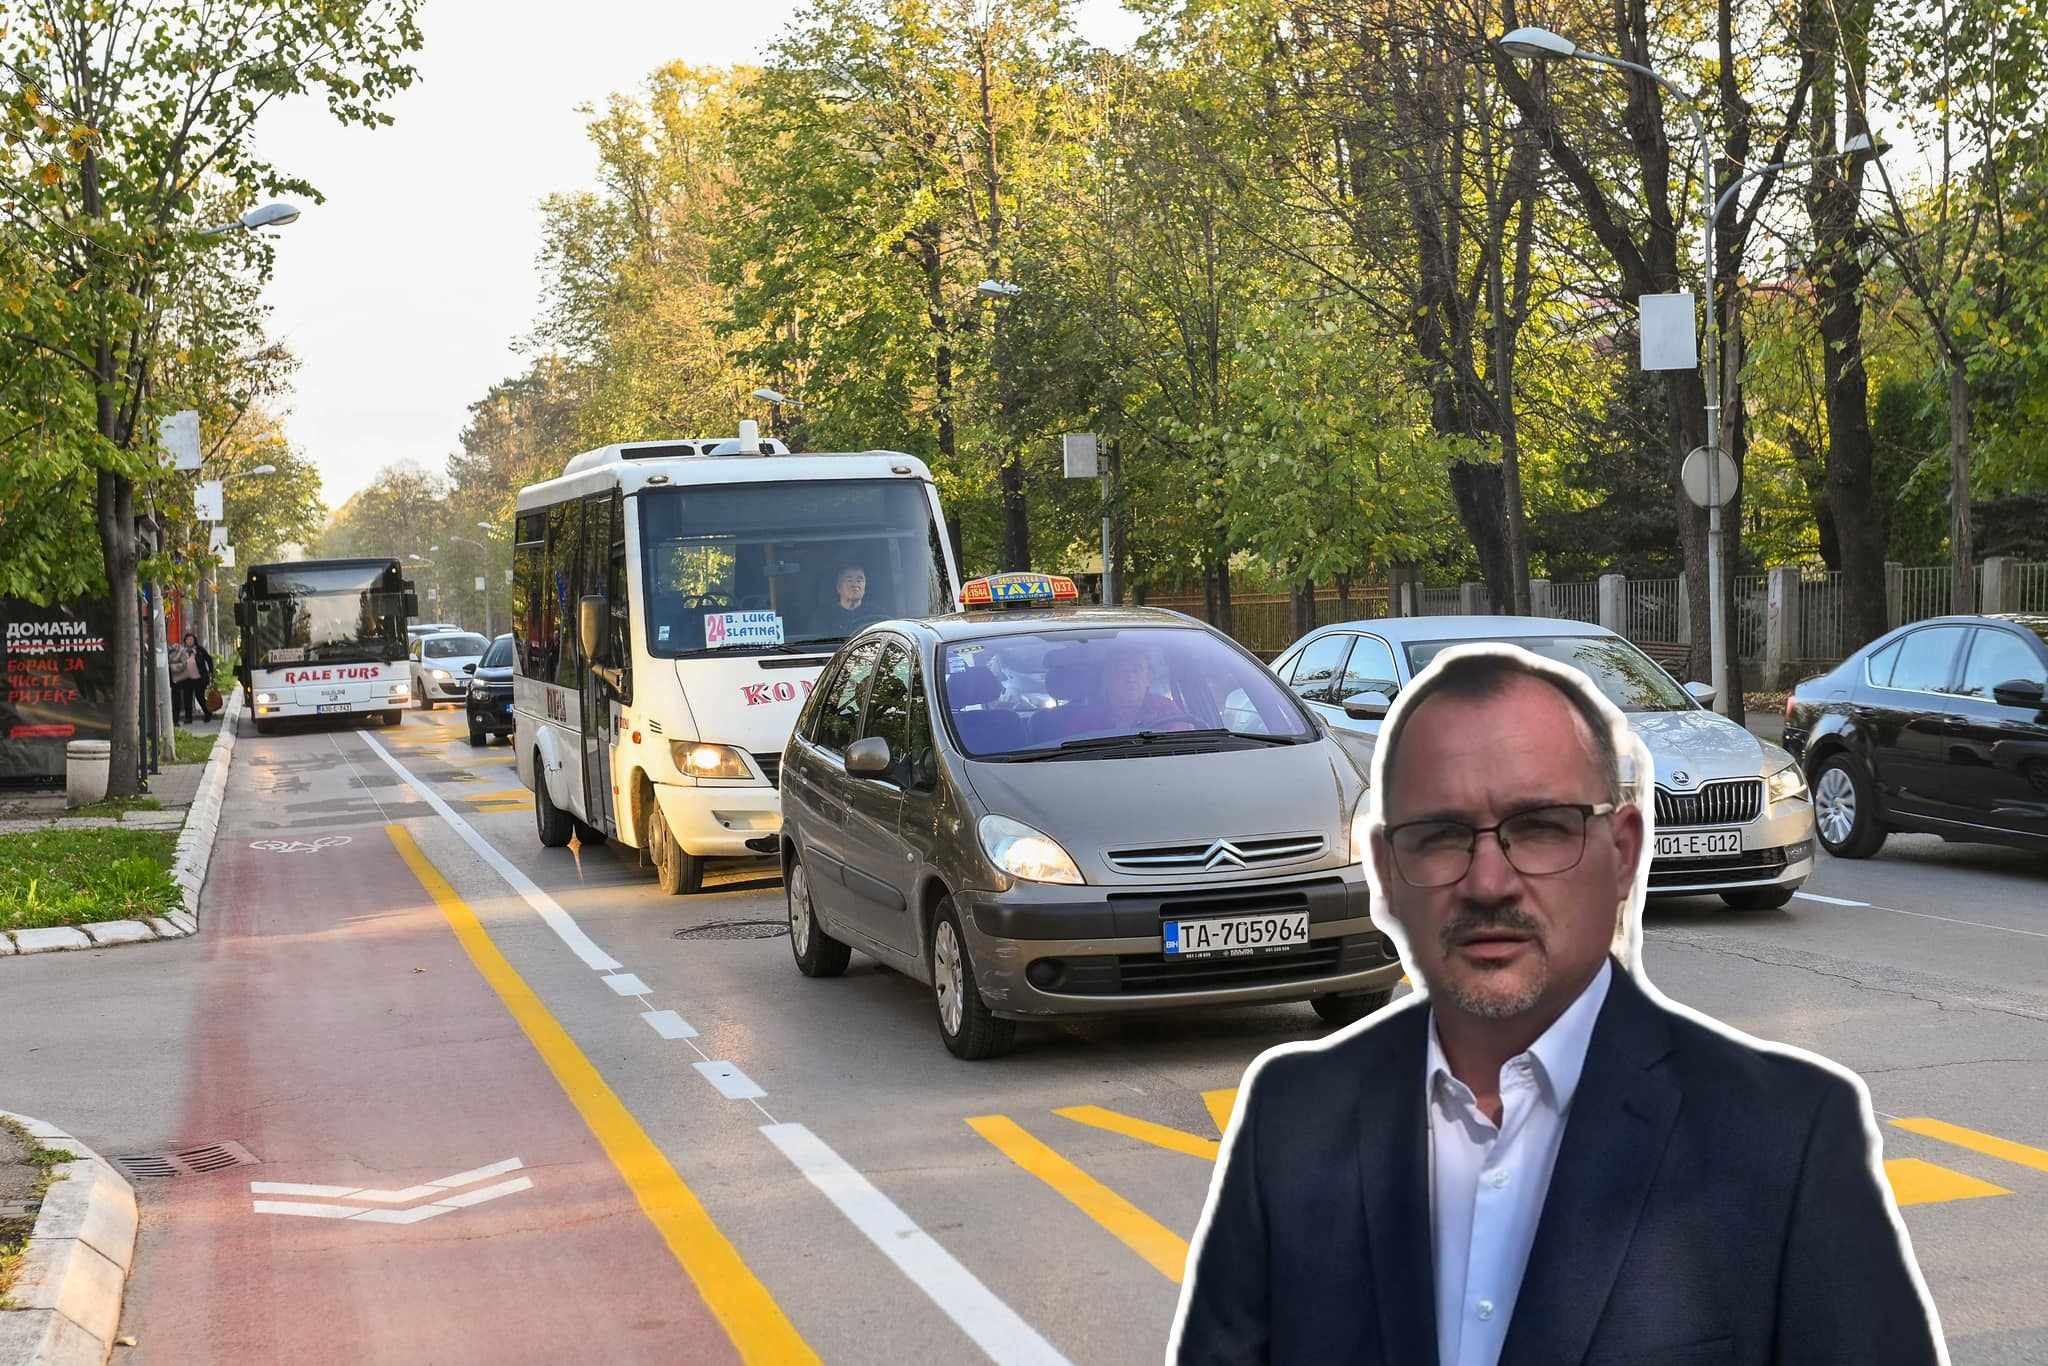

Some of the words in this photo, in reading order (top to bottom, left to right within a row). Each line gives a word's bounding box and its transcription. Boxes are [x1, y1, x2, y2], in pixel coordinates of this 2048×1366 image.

[992, 583, 1050, 596] TAXI
[1054, 581, 1073, 592] 037
[726, 615, 738, 624] B.
[743, 613, 774, 623] LUKA
[6, 621, 87, 638] ДОМАЋИ
[708, 615, 725, 642] 24
[727, 626, 775, 637] SLATINA
[66, 657, 86, 671] ЗА
[285, 669, 331, 684] RALE
[336, 666, 379, 680] TURS
[1181, 917, 1306, 949] TA-705964
